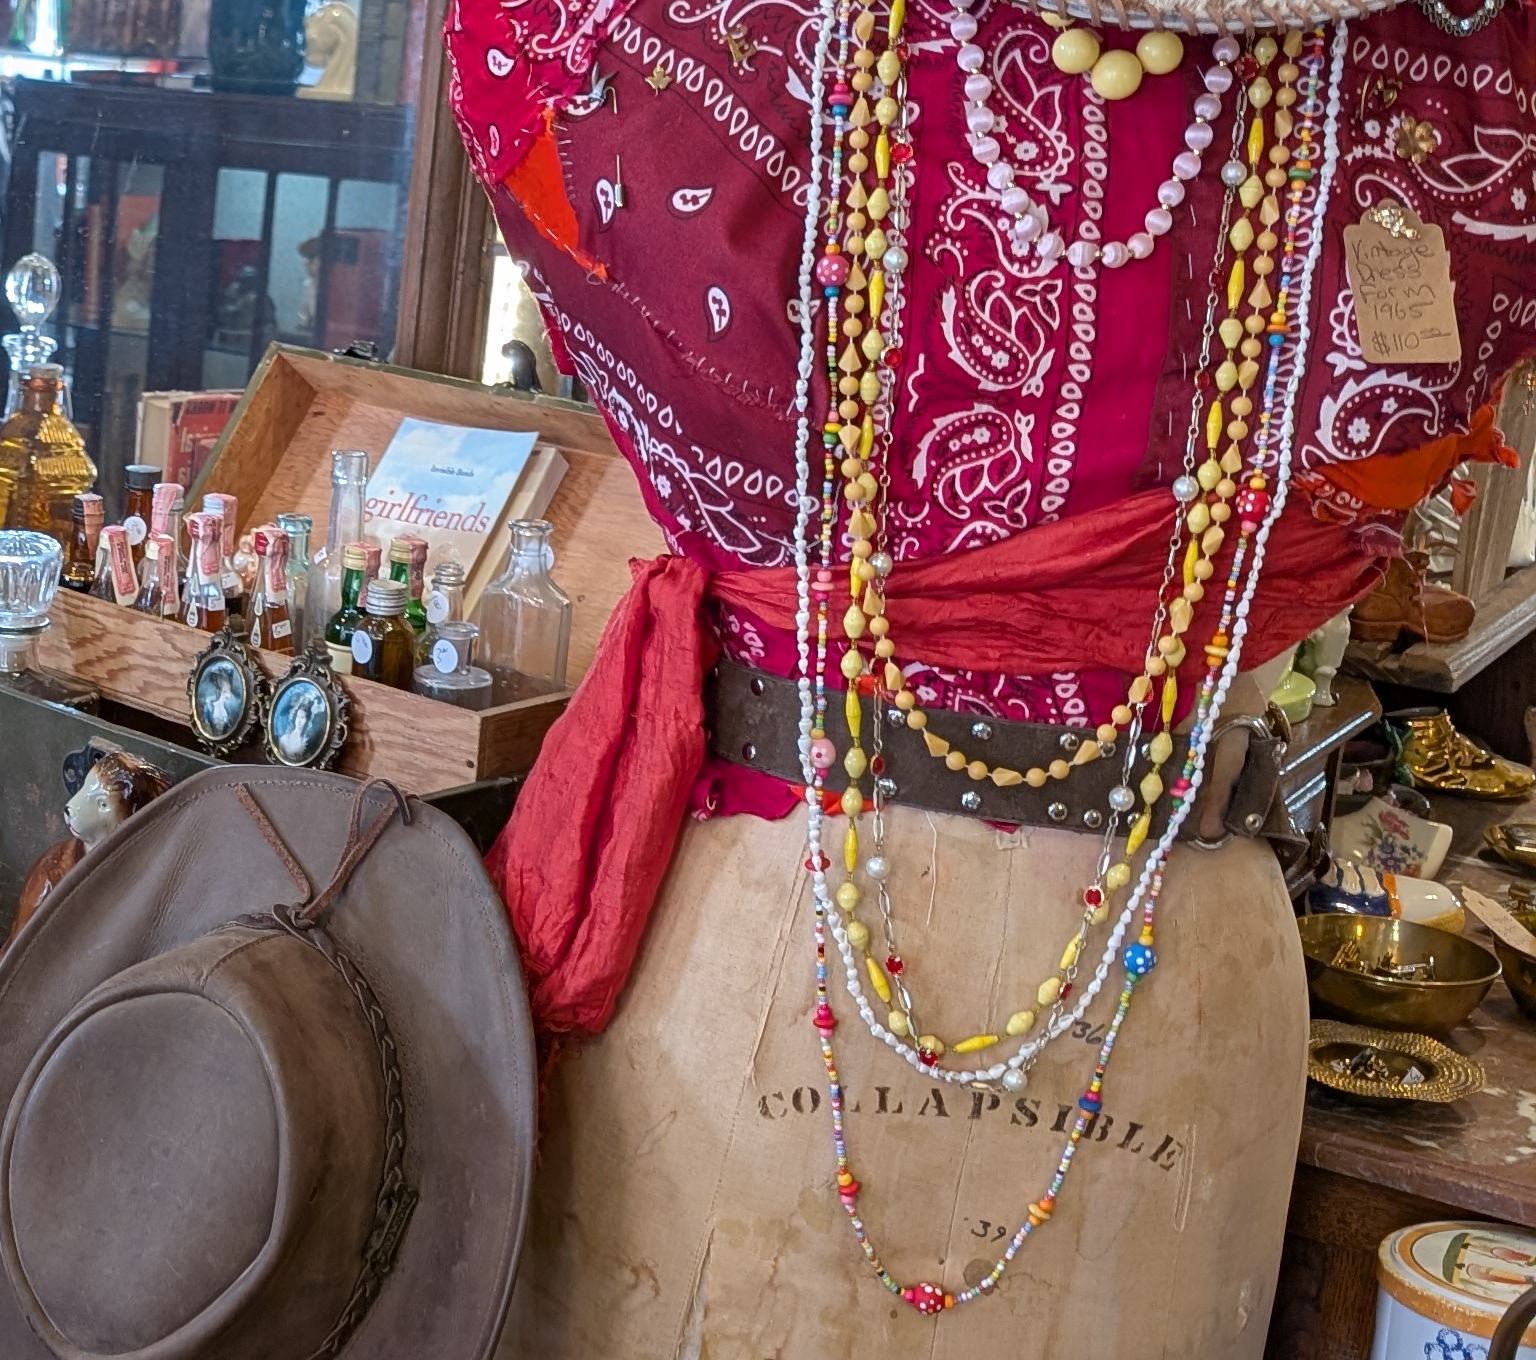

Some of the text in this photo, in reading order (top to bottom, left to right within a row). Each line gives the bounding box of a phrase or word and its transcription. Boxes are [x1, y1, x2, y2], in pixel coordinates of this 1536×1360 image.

[1352, 240, 1435, 268] Vintage
[1356, 261, 1421, 281] Dress
[1374, 301, 1434, 320] 1965
[365, 490, 490, 533] girlfriends
[1071, 1020, 1105, 1045] 36
[757, 1086, 1185, 1172] COLLAPSIBLE
